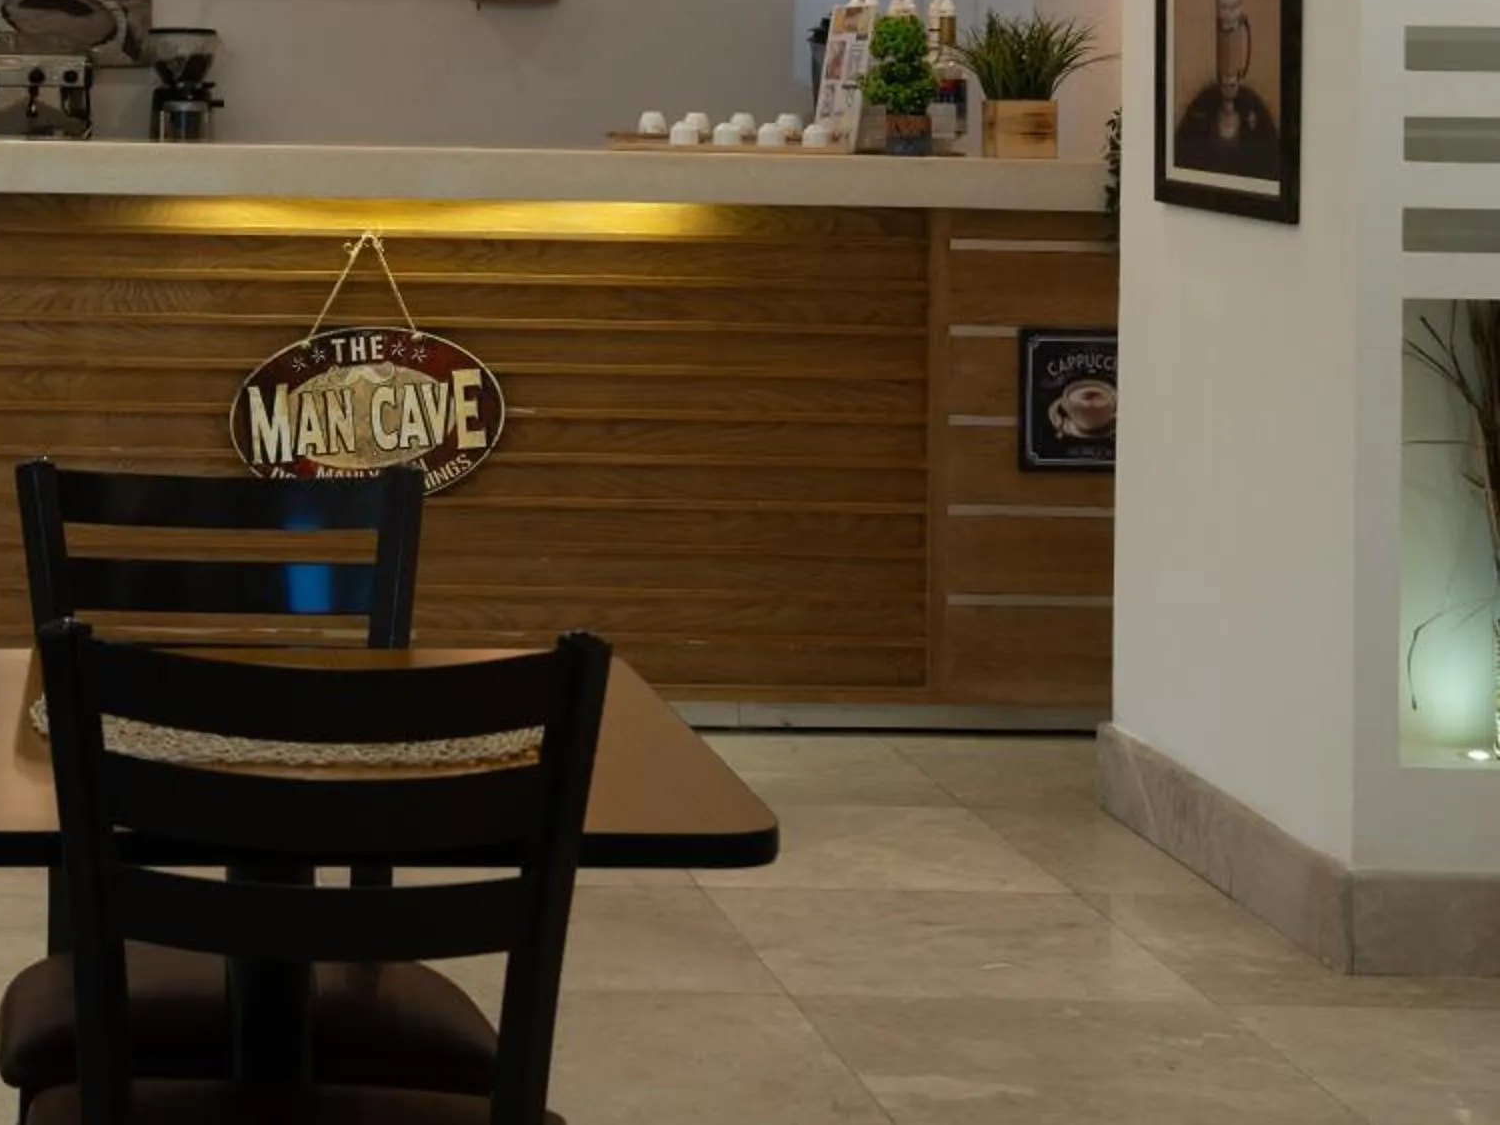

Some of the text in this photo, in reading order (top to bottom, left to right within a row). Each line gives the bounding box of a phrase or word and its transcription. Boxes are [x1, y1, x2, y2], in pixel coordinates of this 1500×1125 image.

[331, 335, 385, 365] THE
[248, 367, 488, 466] MAN CAVE
